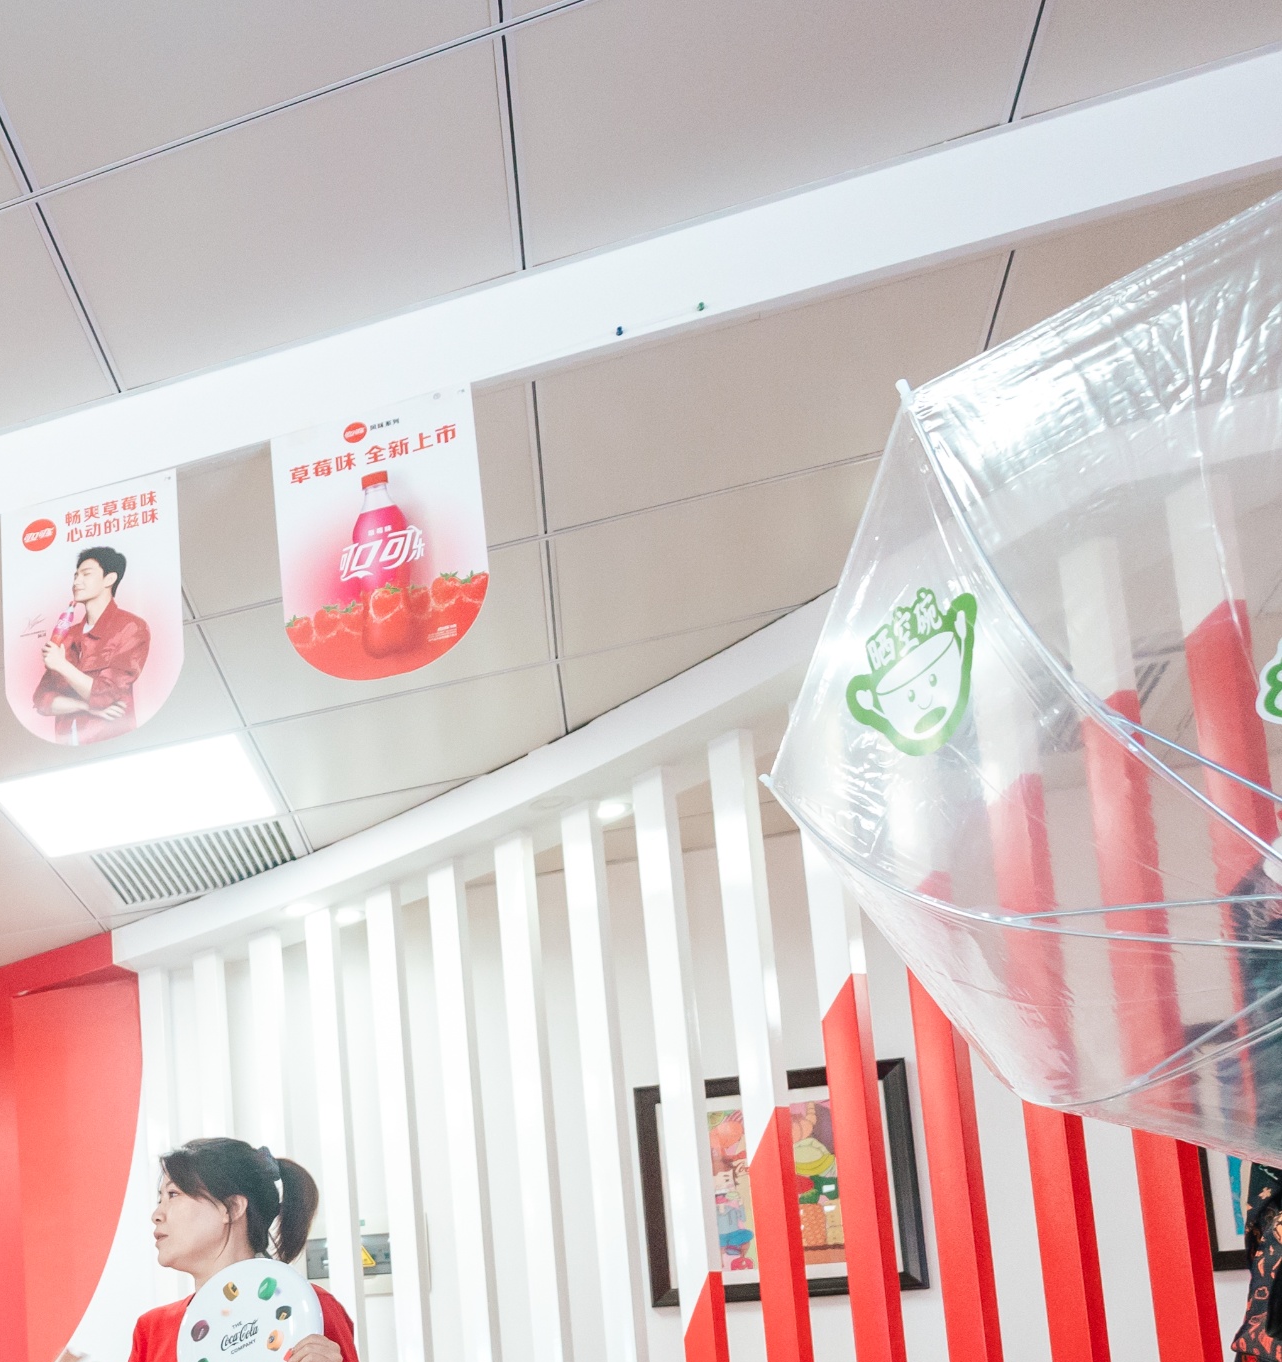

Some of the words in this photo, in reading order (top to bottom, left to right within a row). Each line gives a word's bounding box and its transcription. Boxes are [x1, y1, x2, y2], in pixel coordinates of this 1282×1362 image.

[289, 452, 357, 485] 草莓味
[364, 424, 457, 465] 全新上市
[65, 490, 158, 527] 畅爽草莓味
[66, 507, 159, 543] 心动的滋味
[339, 525, 426, 582] 可口可乐
[220, 1317, 258, 1352] Coca-Cola
[230, 1338, 256, 1355] COMPANY
